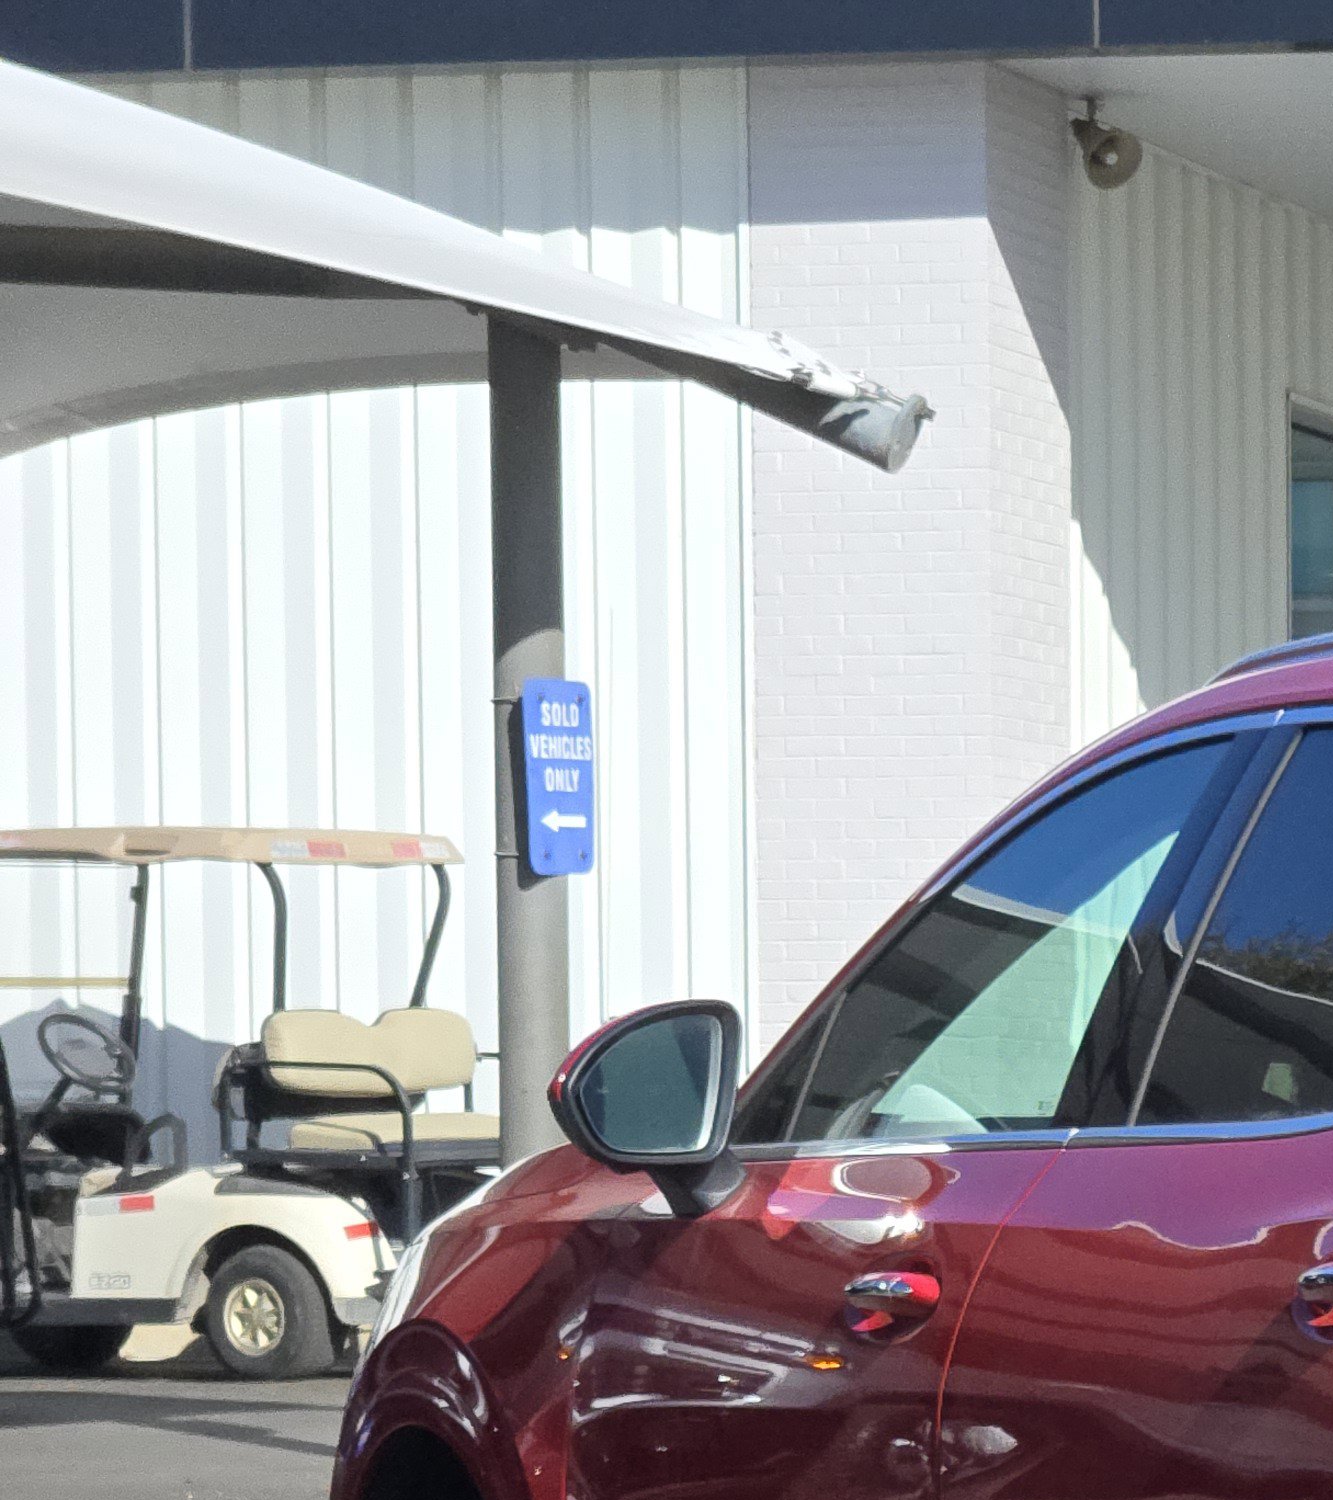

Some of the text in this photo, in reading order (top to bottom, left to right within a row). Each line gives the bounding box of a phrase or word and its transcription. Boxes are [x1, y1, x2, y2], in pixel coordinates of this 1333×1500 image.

[541, 702, 580, 727] SOLD
[530, 733, 592, 761] VEHICLES
[544, 767, 580, 793] ONLY
